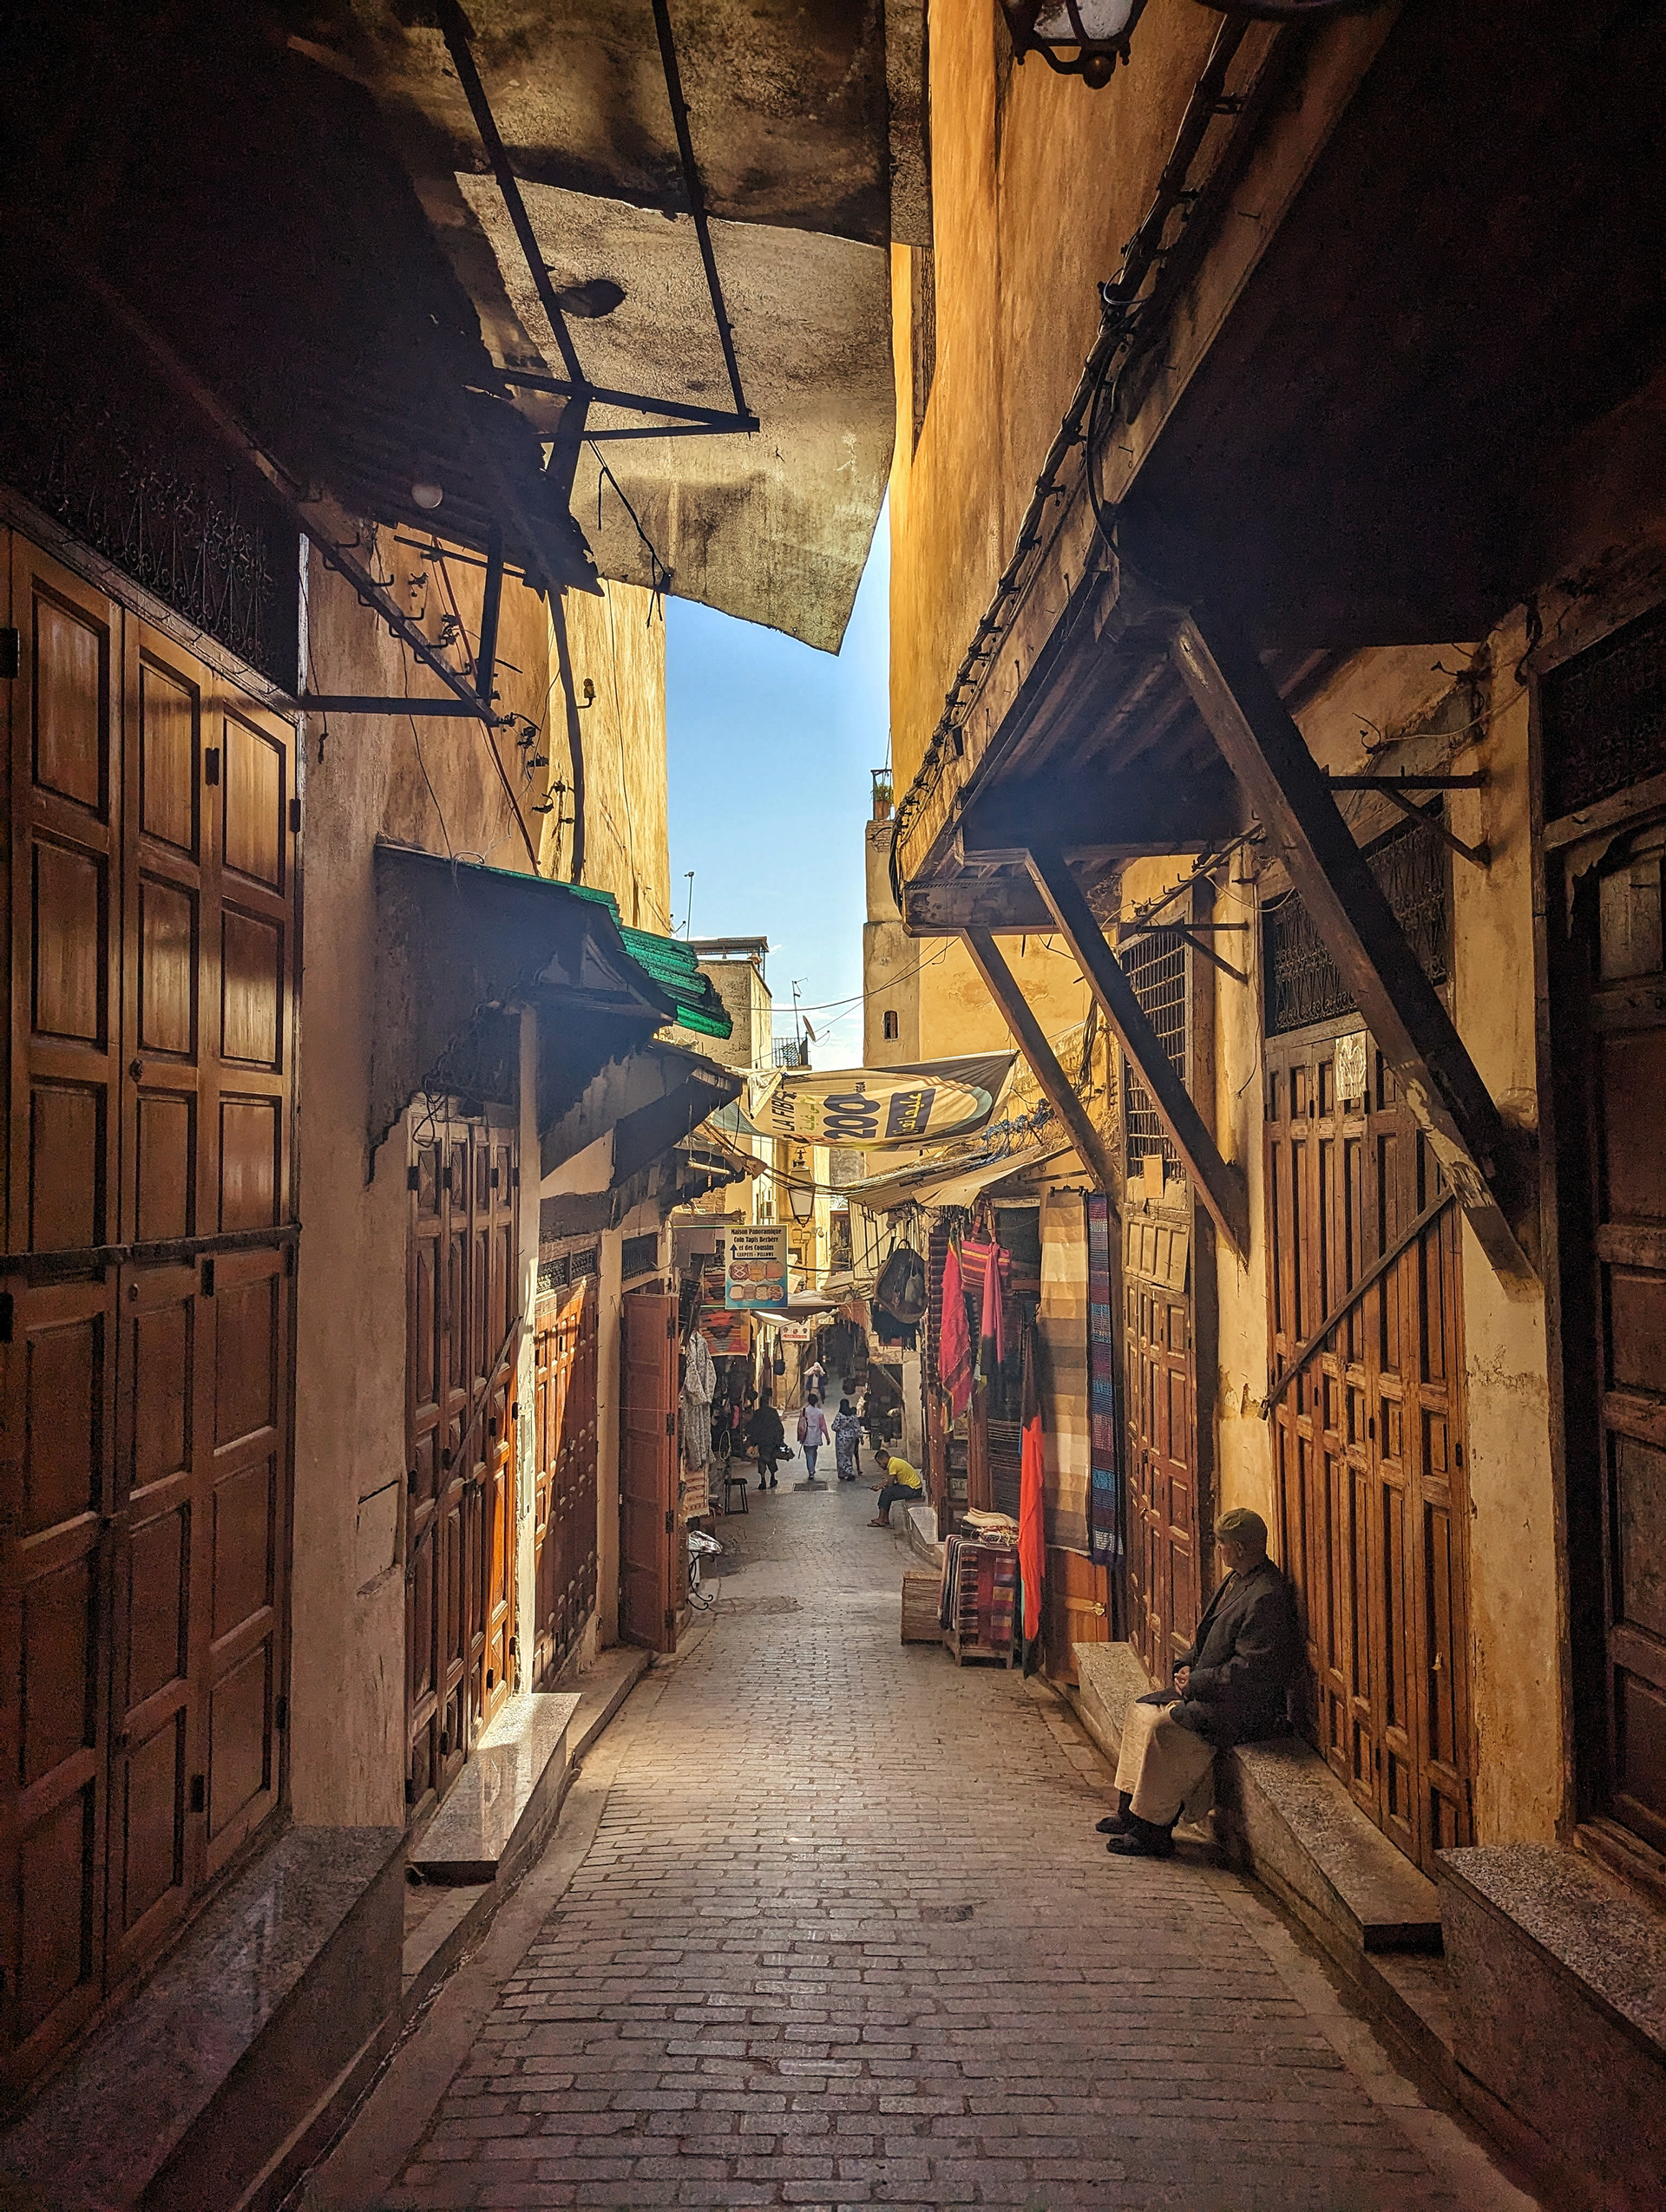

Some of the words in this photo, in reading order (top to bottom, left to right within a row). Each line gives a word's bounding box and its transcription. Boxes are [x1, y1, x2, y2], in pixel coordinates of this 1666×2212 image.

[771, 1090, 797, 1119] FIBR
[823, 1093, 881, 1139] 200
[853, 1081, 866, 1093] ÉGA
[771, 1118, 795, 1131] LA
